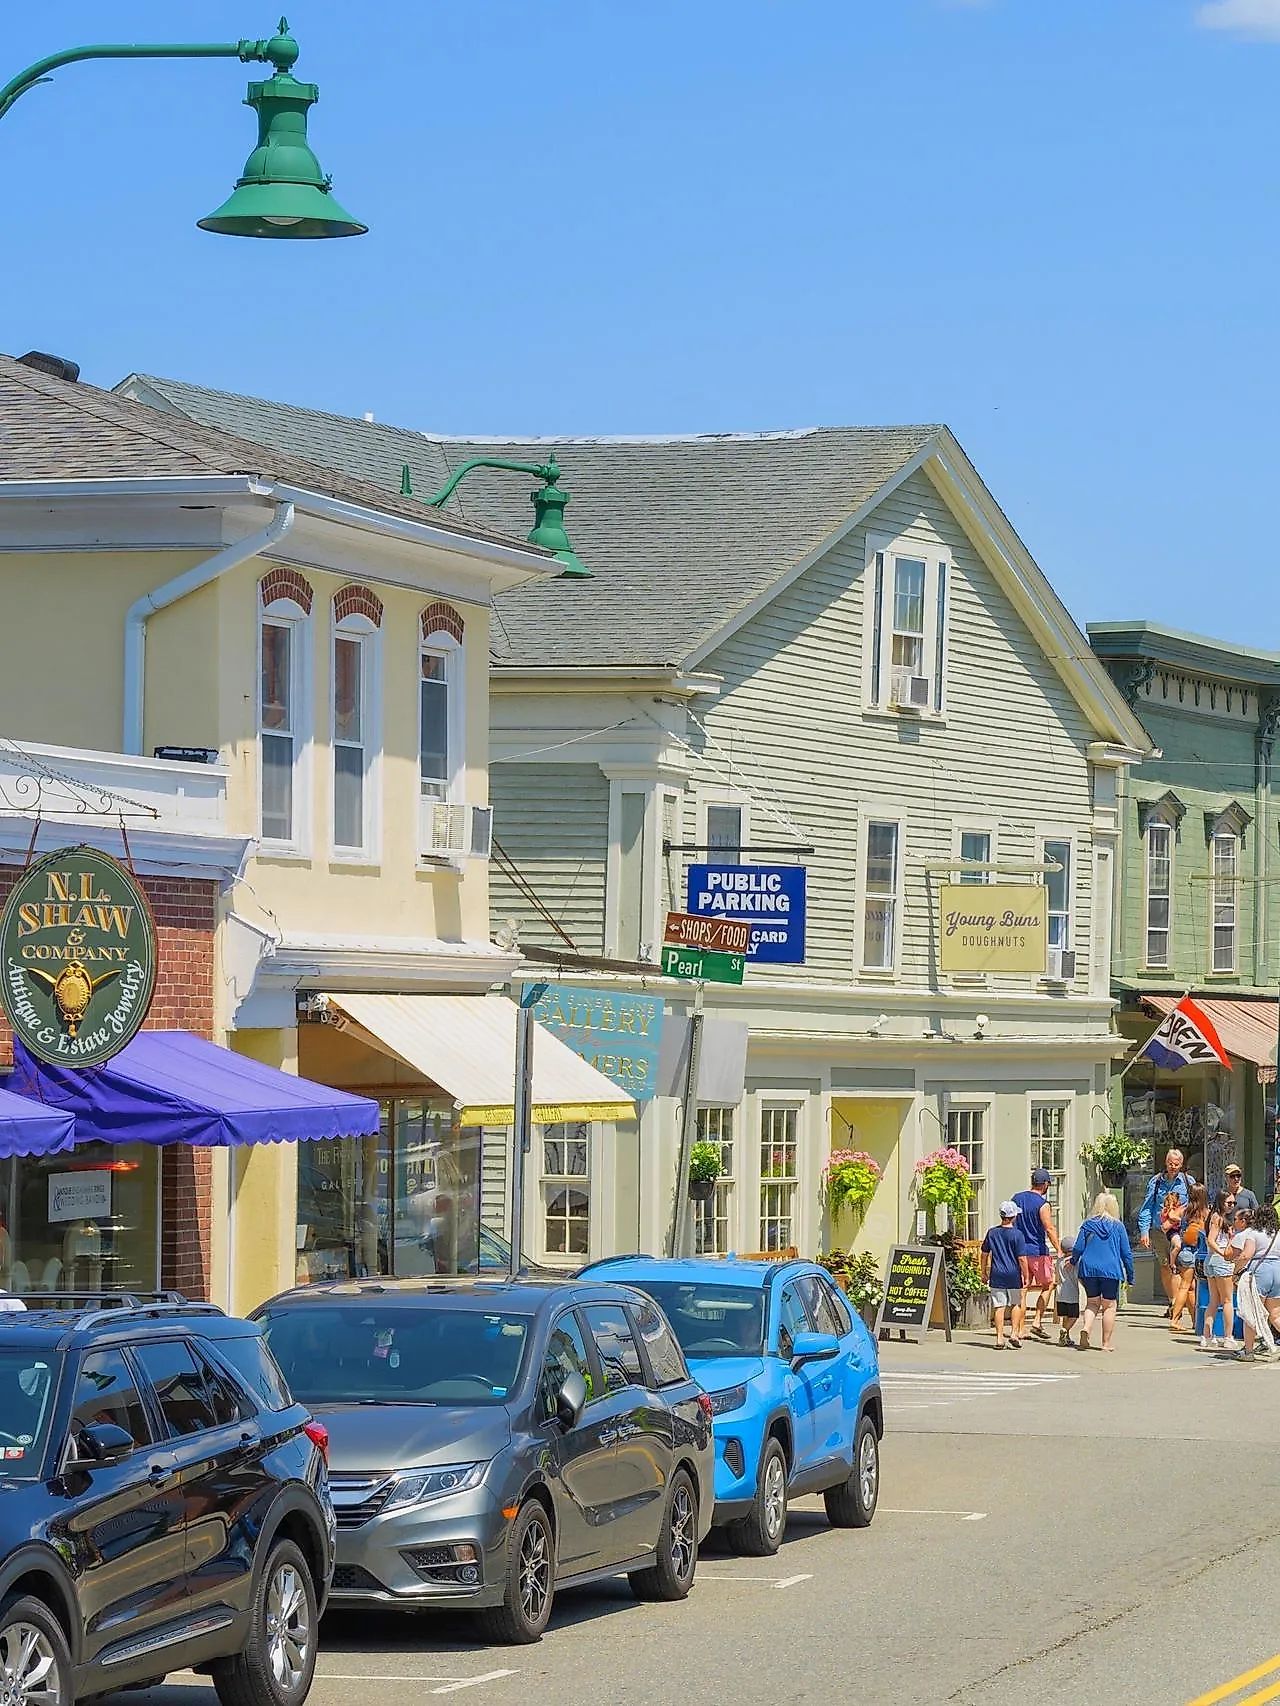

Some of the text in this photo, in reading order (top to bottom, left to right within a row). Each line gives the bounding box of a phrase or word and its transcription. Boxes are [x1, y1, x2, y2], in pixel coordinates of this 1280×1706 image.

[45, 871, 112, 902] N.L.
[707, 872, 782, 891] PUBLIC
[698, 892, 790, 912] PARKING
[18, 901, 136, 939] SHAW
[945, 910, 1041, 937] Young Buns
[67, 926, 87, 946] &
[679, 918, 748, 948] SHOPS/FOOD
[751, 930, 789, 944] CARD
[962, 935, 1025, 947] DOUGHNUTS
[21, 944, 131, 961] COMPANY
[746, 942, 760, 955] LY
[666, 951, 742, 976] Pearl St
[8, 956, 146, 1055] Antique & Estate Jewelry
[531, 1001, 656, 1036] GALLERY
[1157, 1013, 1217, 1059] OPEN
[900, 1253, 928, 1266] Fresh
[892, 1265, 931, 1276] DOUGHNUTS
[904, 1277, 913, 1286] &
[889, 1286, 929, 1298] HOT COFFEE
